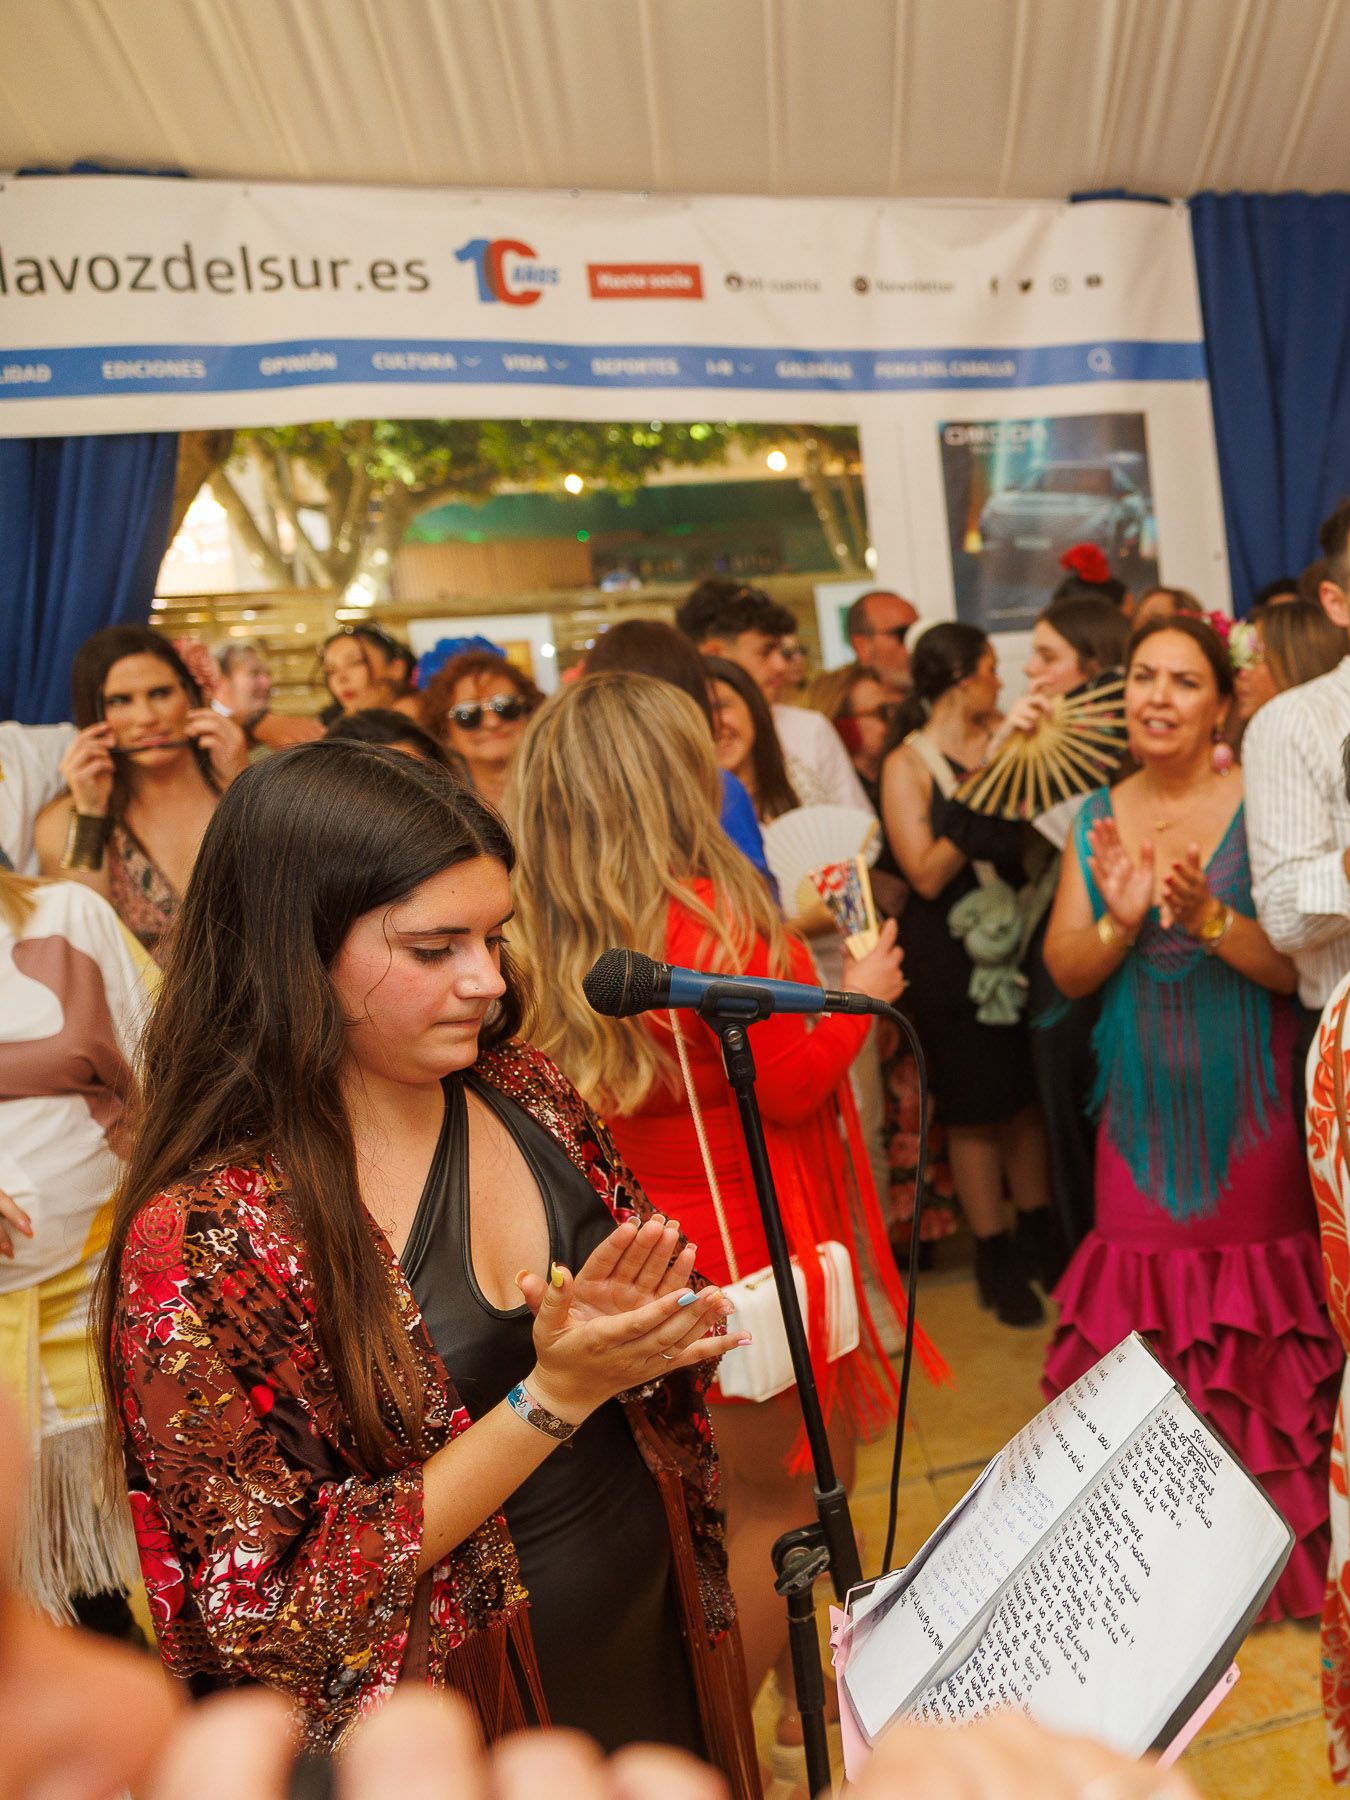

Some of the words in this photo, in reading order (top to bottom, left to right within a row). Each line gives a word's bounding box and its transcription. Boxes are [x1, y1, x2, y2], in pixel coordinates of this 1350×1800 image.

[0, 240, 430, 297] lavozdelsur.es
[1158, 1473, 1164, 1484] Y
[1186, 1476, 1198, 1493] POR
[1099, 1564, 1108, 1579] ME
[1037, 1605, 1046, 1619] NO
[1054, 1609, 1064, 1623] ME
[1011, 1634, 1021, 1652] DEL
